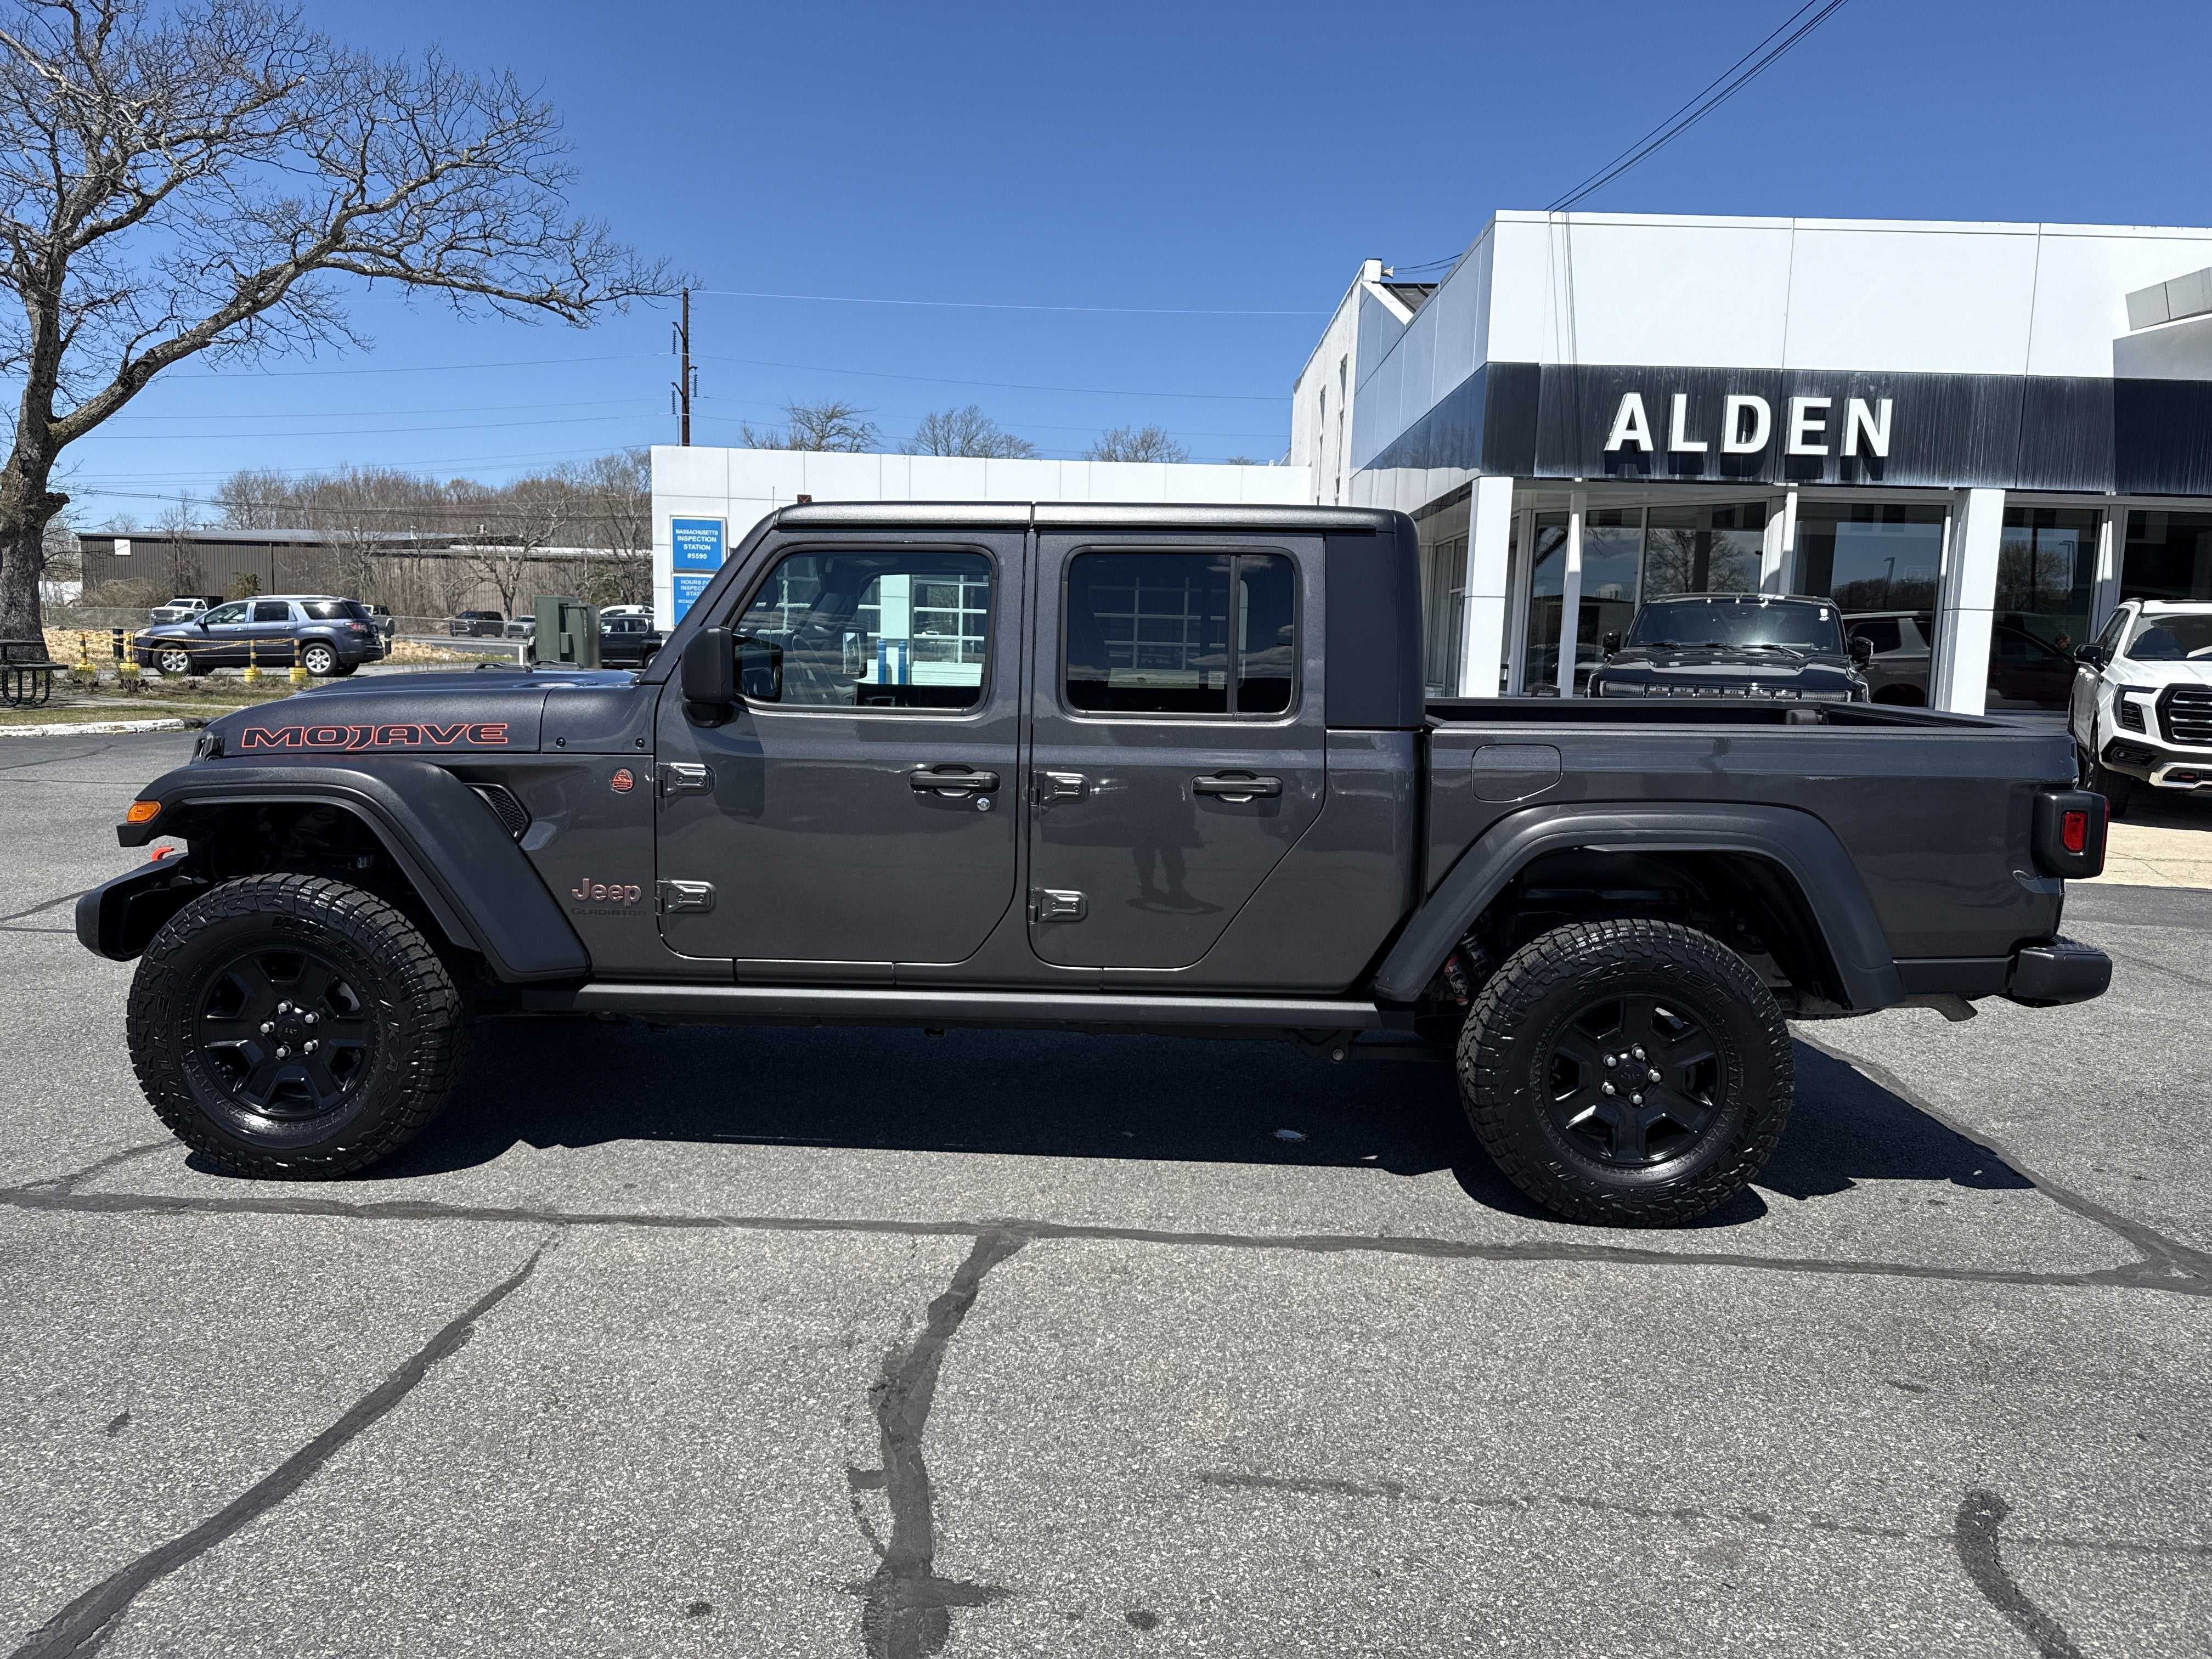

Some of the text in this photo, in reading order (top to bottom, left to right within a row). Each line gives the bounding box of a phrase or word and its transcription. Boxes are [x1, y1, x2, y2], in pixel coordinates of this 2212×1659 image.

[1604, 392, 1893, 458] ALDEN
[241, 724, 508, 749] MOJAVE
[572, 878, 641, 907] Jeep
[571, 908, 647, 917] GLADIATOR
[1572, 961, 1733, 1006] FALKEN
